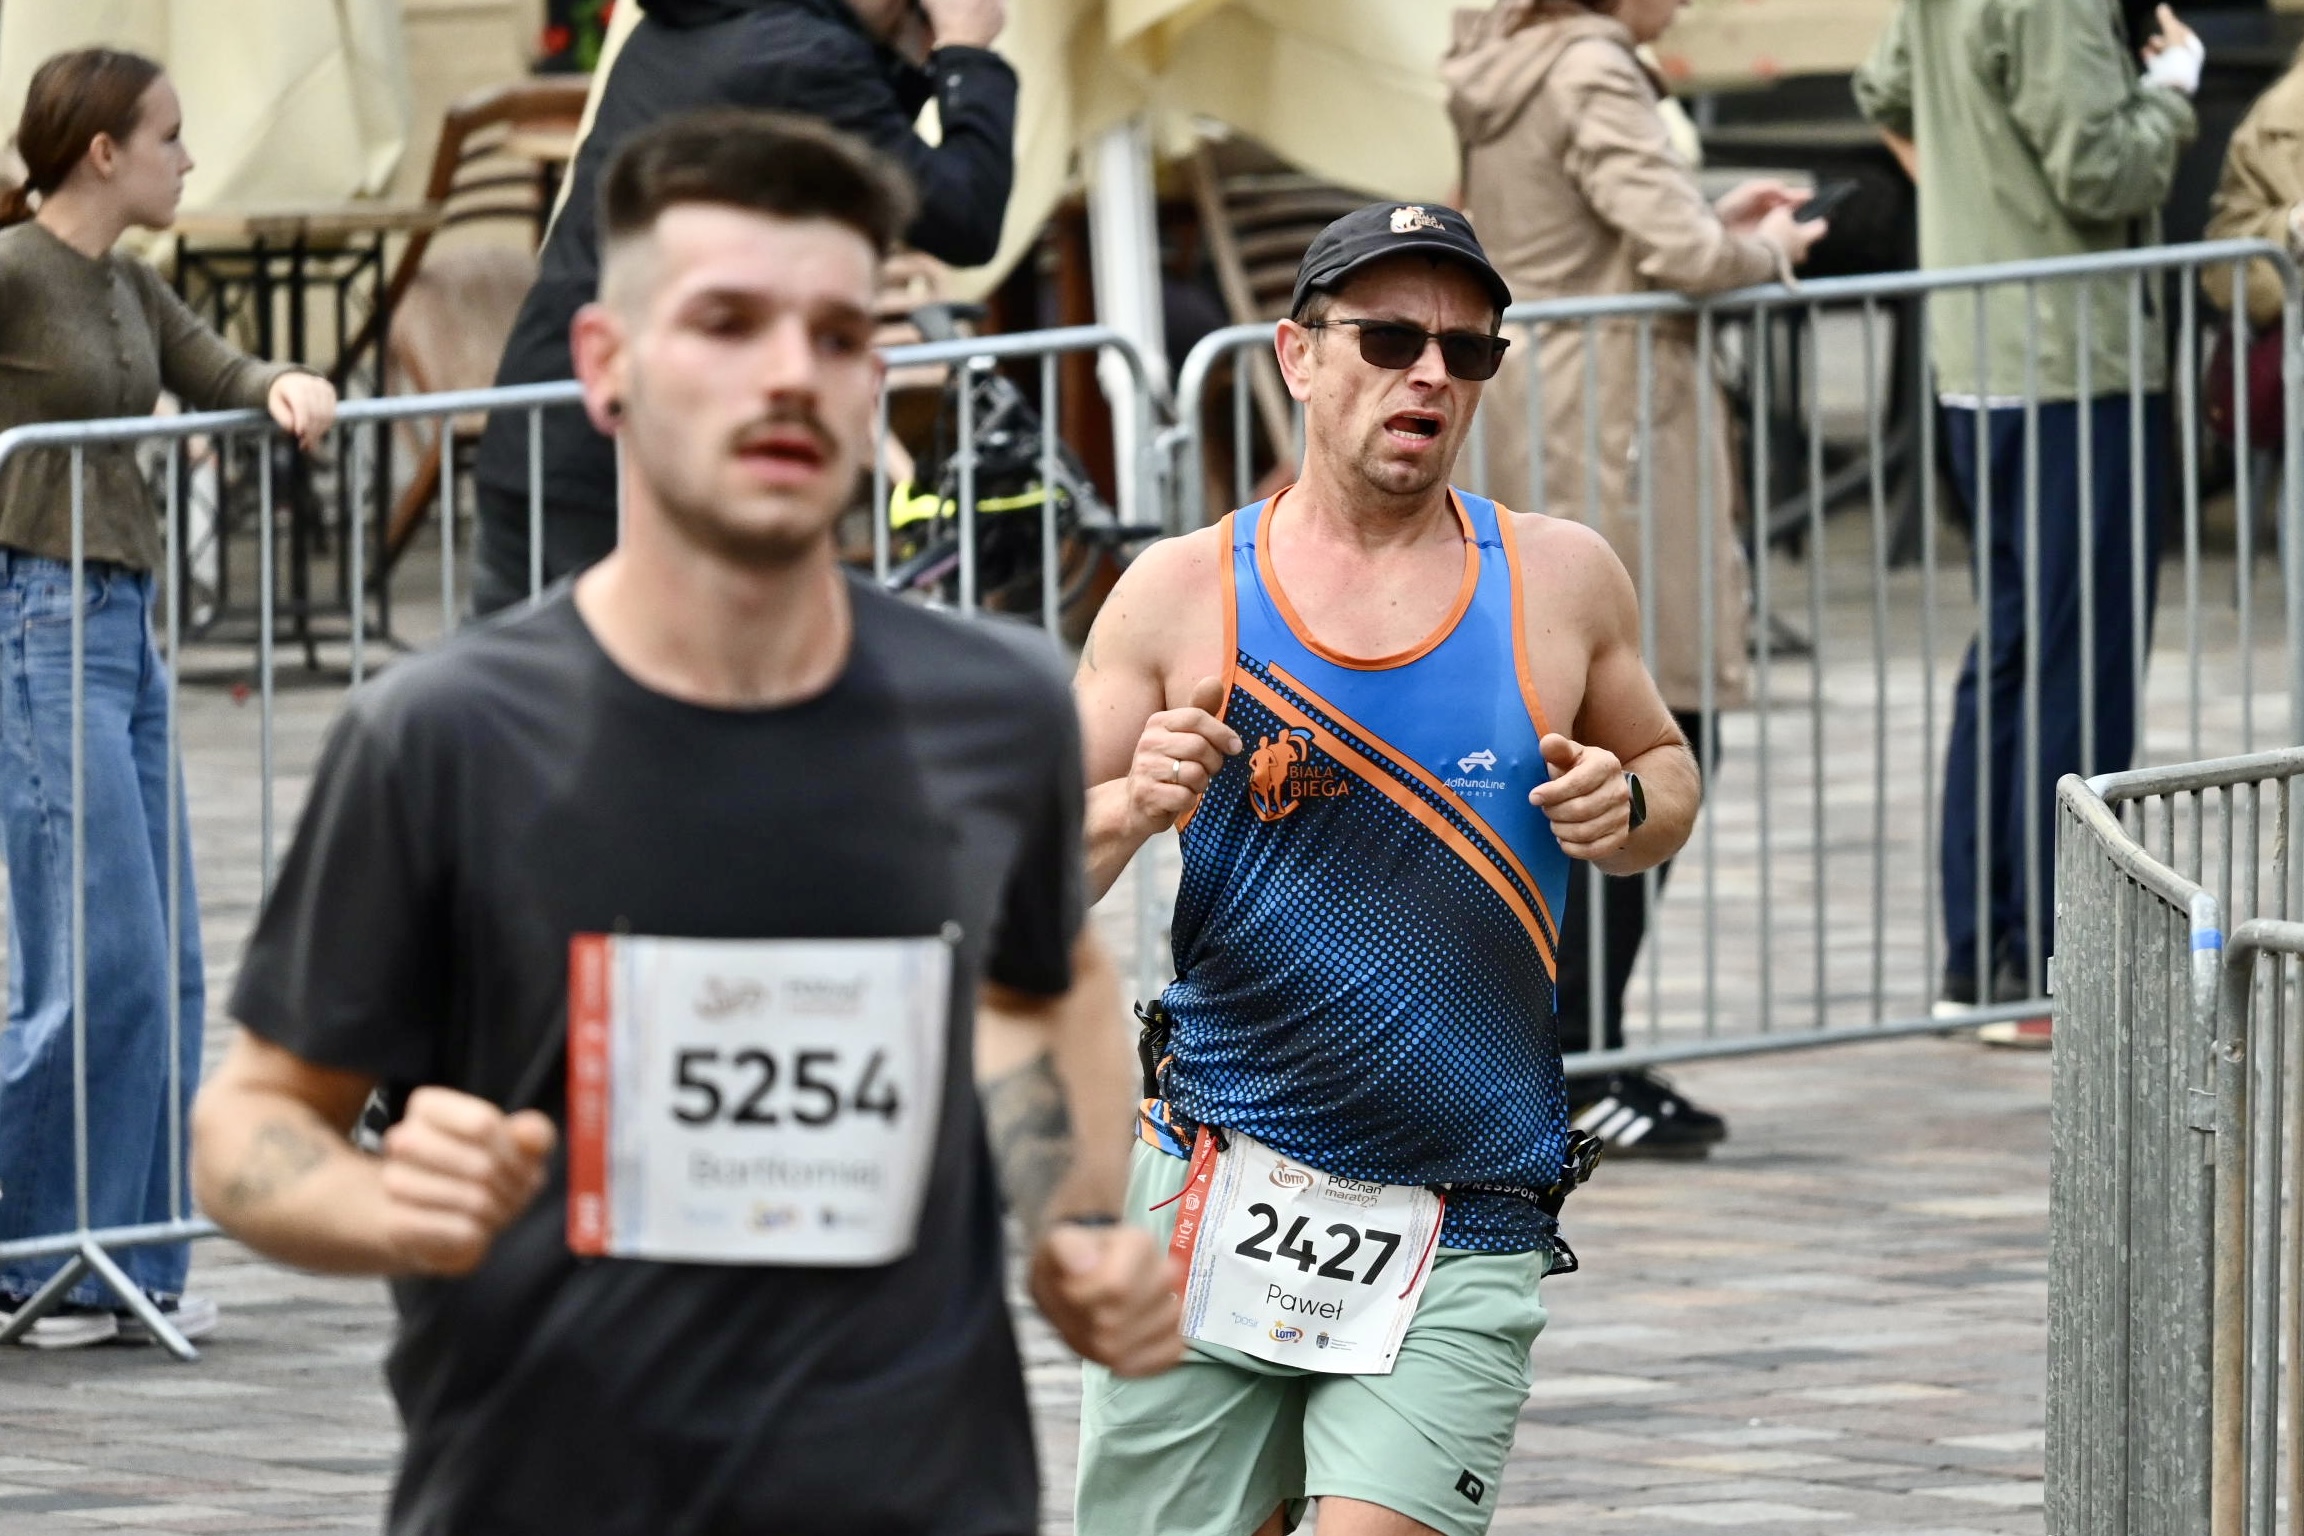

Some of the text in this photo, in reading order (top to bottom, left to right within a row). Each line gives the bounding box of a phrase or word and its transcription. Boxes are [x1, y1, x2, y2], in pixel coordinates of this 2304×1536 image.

[1290, 779, 1349, 797] BIEGA
[671, 1046, 903, 1129] 5254
[1278, 1170, 1305, 1185] LOTTO
[1235, 1202, 1402, 1286] 2427
[1266, 1283, 1344, 1321] Paweł
[1275, 1329, 1297, 1339] LOTTO
